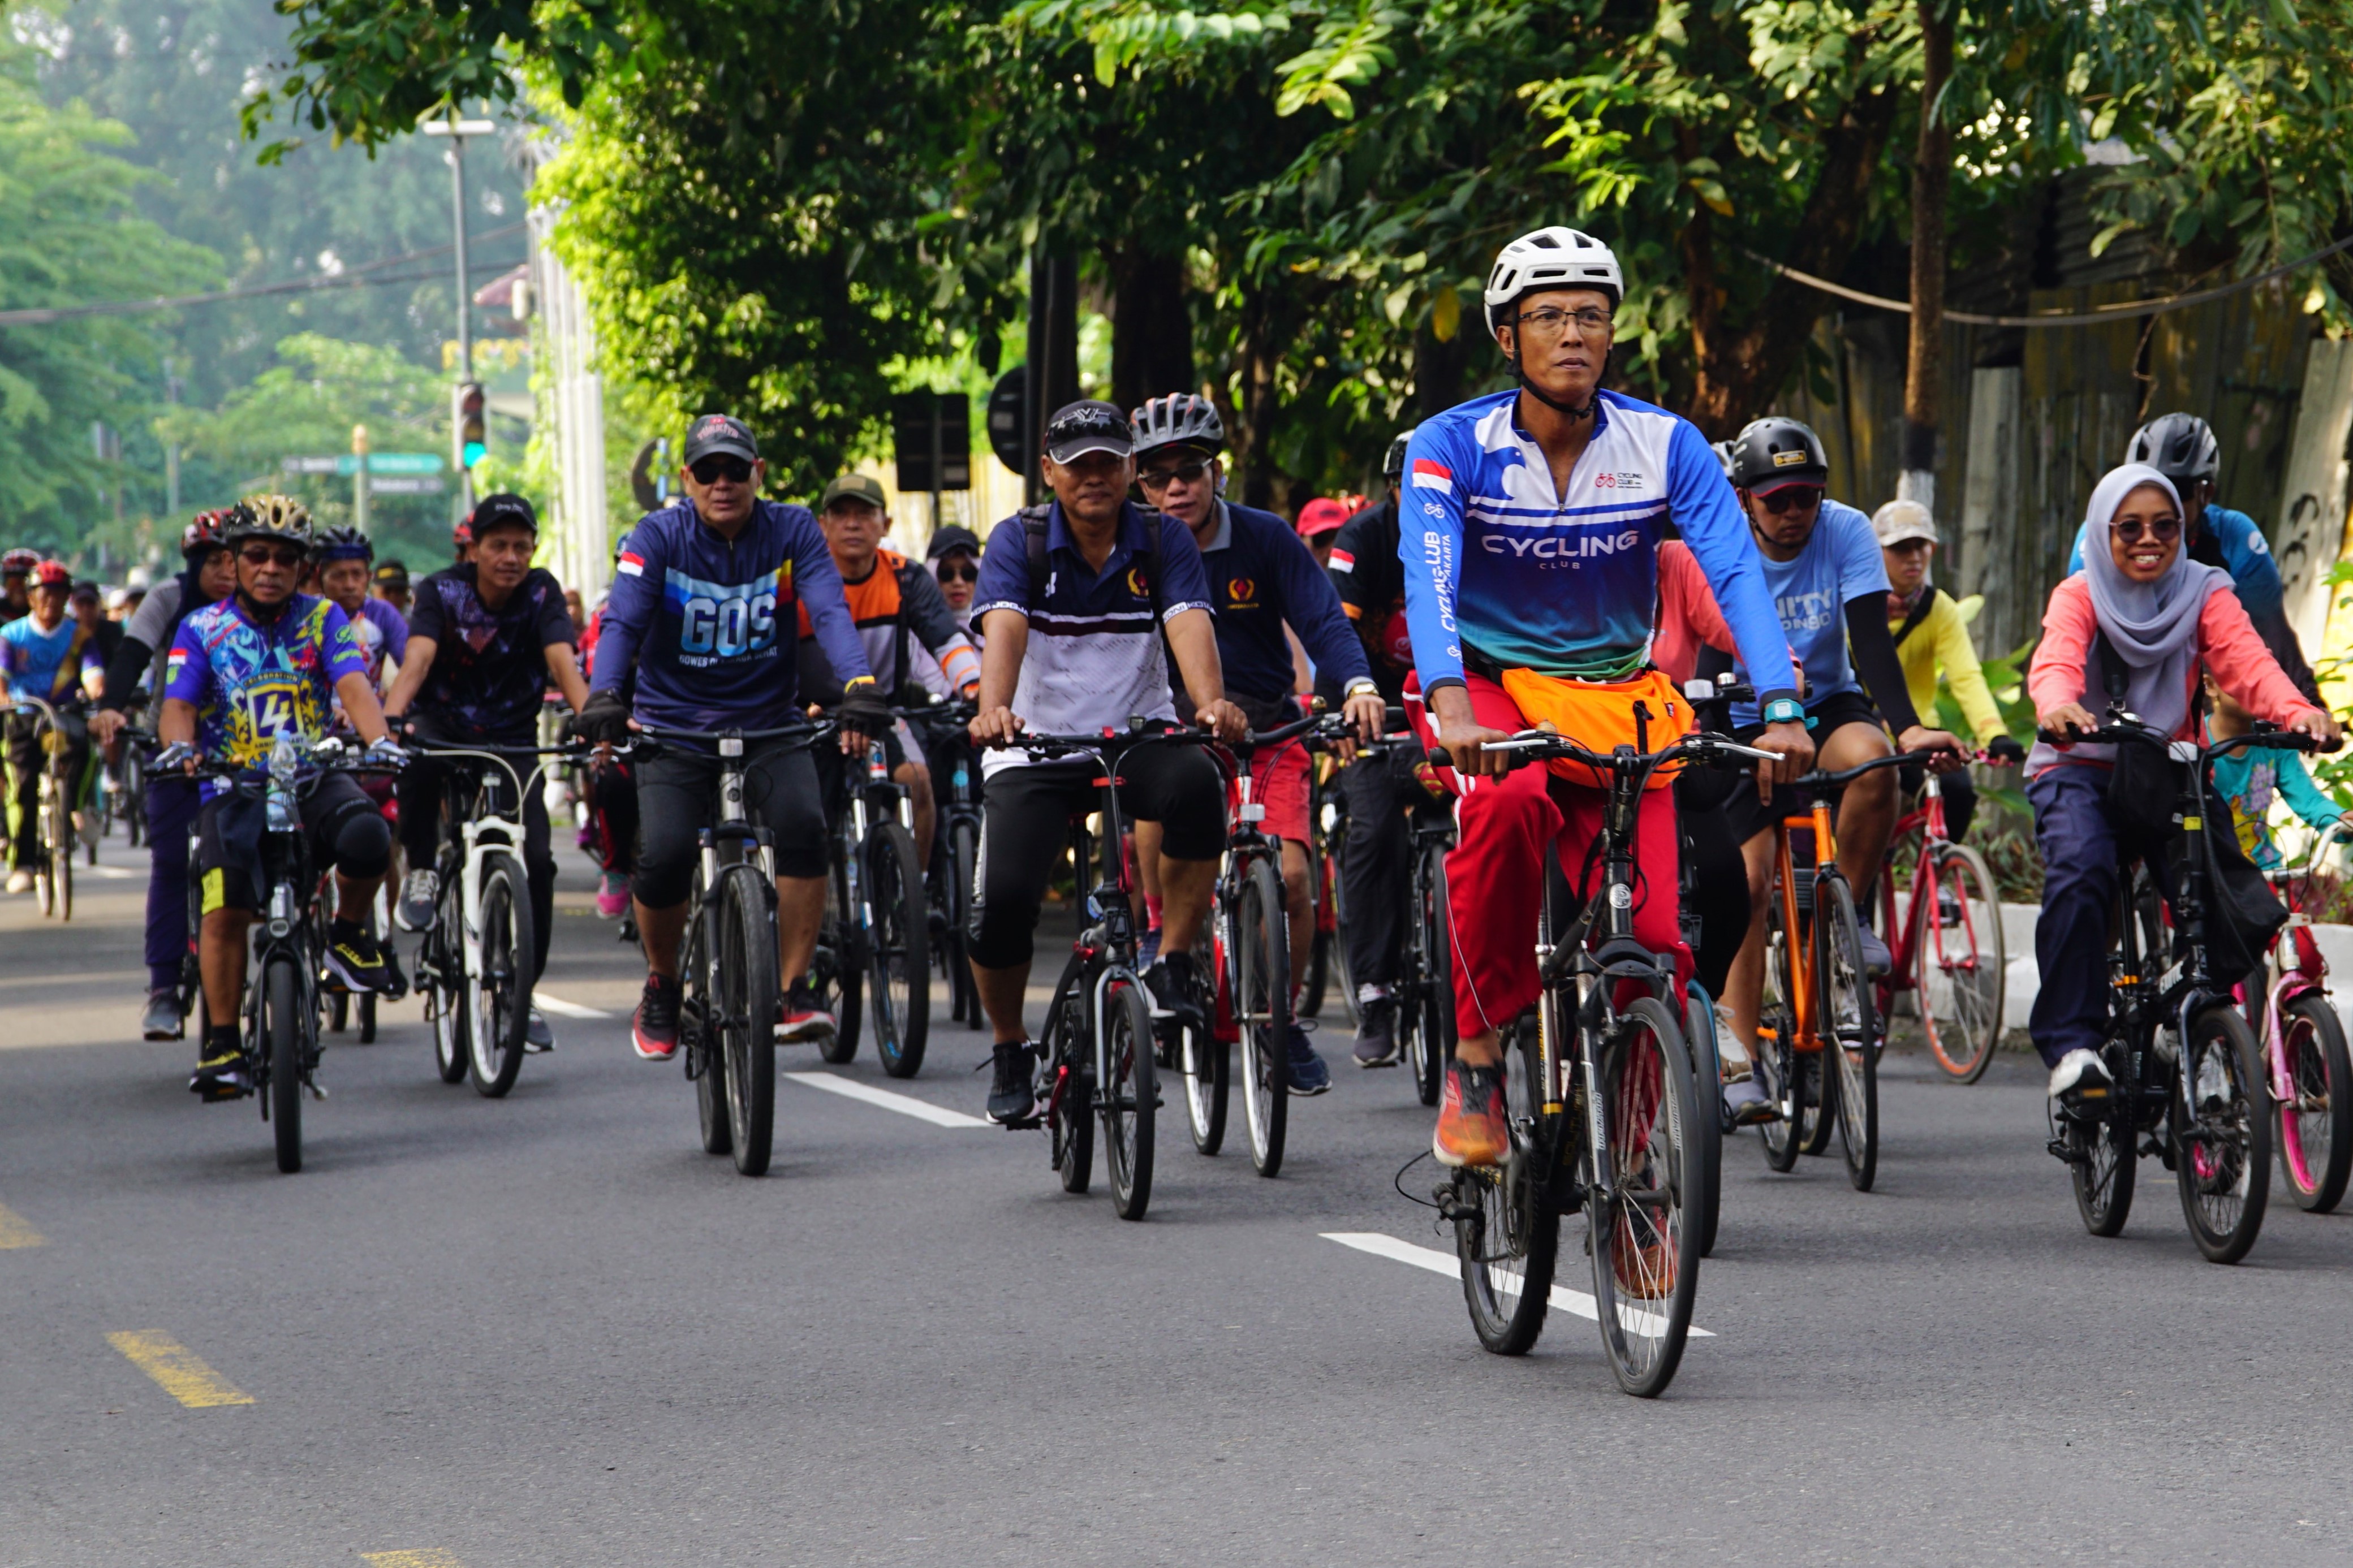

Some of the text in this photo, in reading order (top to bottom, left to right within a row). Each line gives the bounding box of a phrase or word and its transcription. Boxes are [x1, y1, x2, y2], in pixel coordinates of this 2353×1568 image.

[1424, 531, 1441, 568] LUB
[1481, 530, 1639, 558] CYCLING
[1539, 560, 1580, 569] CLUB
[1163, 605, 1186, 621] KONI
[680, 593, 777, 658] GOS
[255, 737, 304, 749] ANNIVARY
